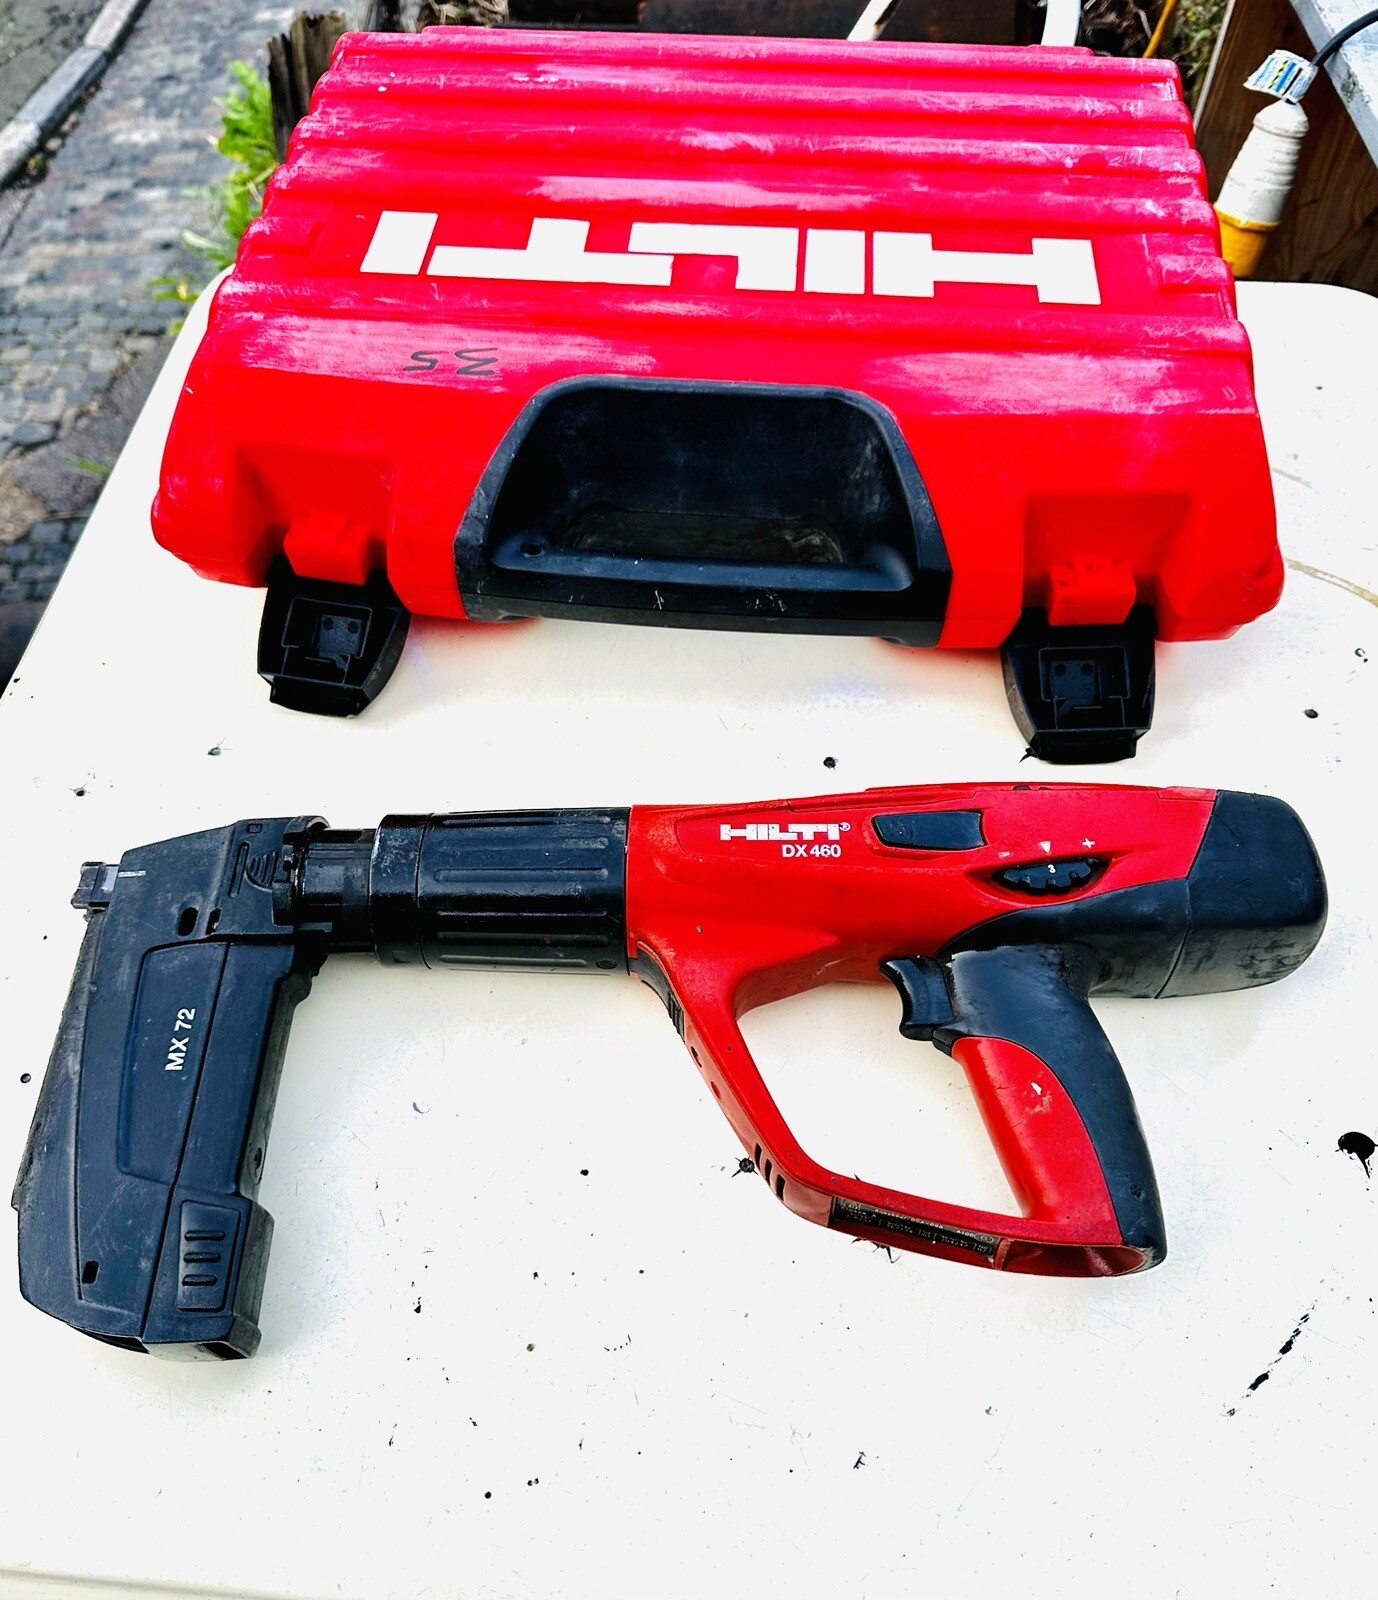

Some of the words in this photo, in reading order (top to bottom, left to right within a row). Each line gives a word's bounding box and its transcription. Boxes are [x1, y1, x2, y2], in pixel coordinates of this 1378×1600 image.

[361, 210, 1101, 305] HILTI
[782, 844, 807, 857] DX
[810, 844, 841, 858] 460
[1047, 864, 1056, 874] 3
[174, 1008, 196, 1032] 72
[165, 1037, 190, 1071] MX
